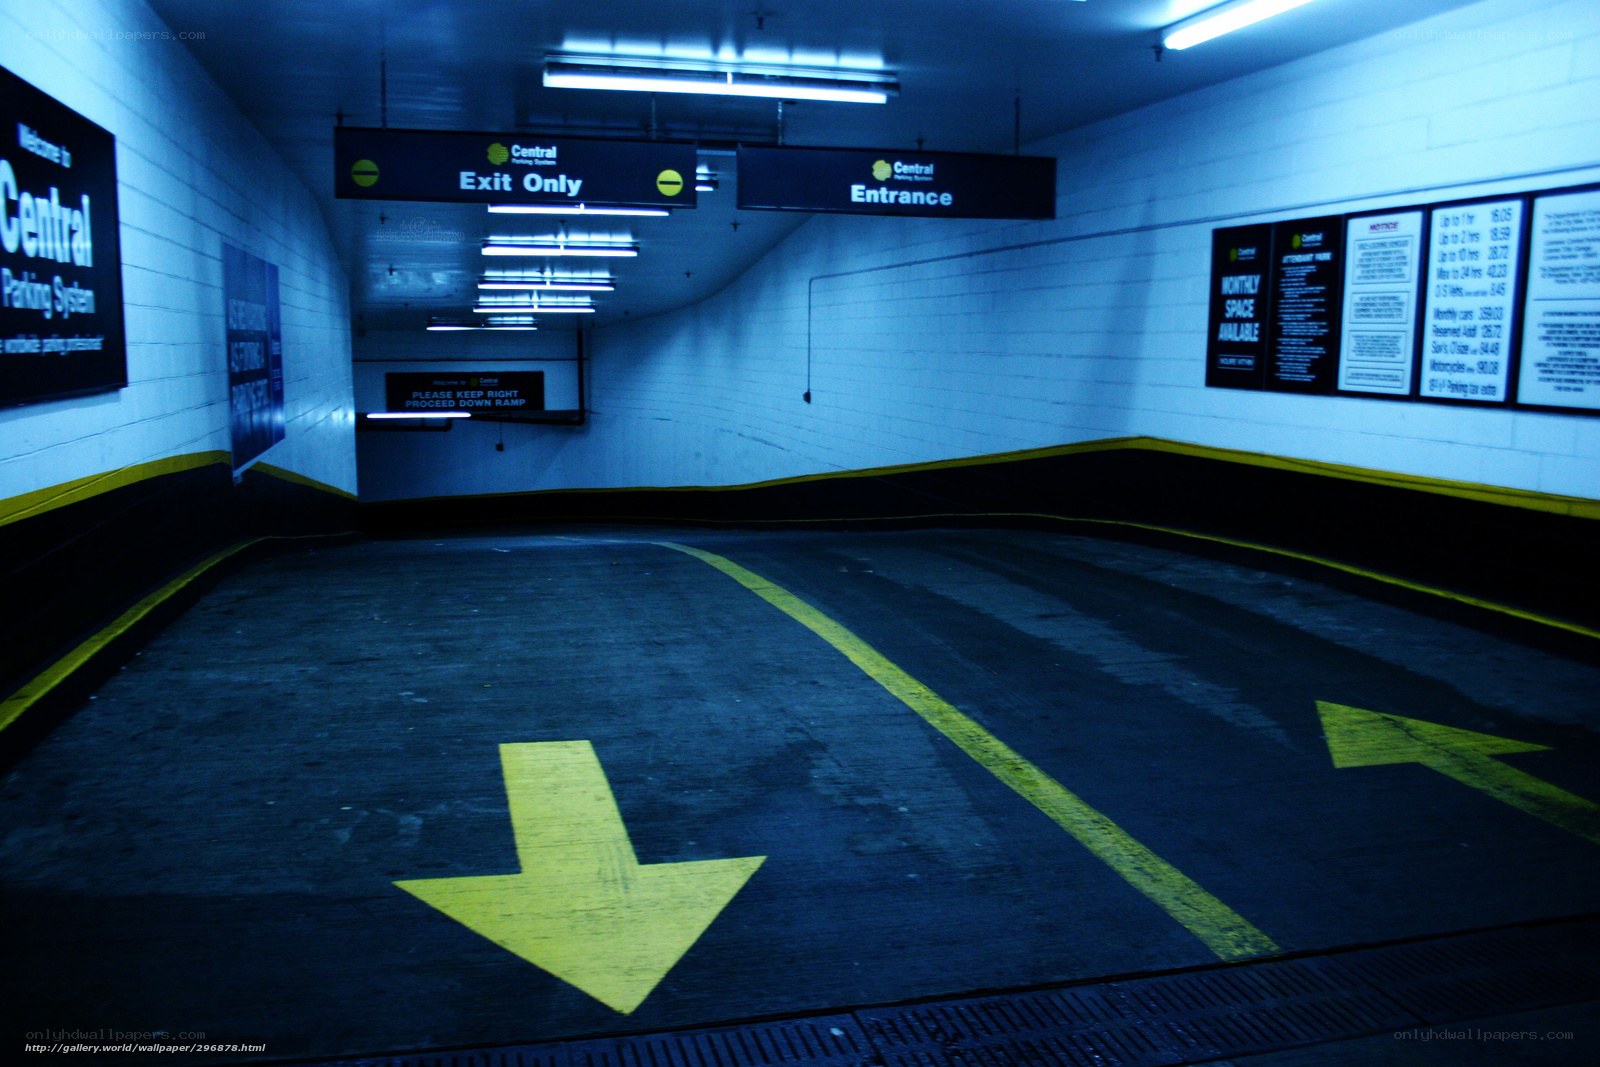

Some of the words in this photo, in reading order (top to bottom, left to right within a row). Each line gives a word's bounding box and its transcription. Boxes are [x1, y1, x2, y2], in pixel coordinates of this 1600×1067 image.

[18, 122, 60, 164] Welcome
[61, 146, 71, 169] to
[511, 144, 557, 159] Central
[893, 161, 934, 175] Central
[459, 171, 513, 192] Exit
[522, 173, 583, 197] Only
[850, 184, 953, 206] Entrance
[0, 159, 92, 267] Central
[1440, 214, 1450, 228] Up
[1451, 214, 1460, 227] to
[1490, 207, 1513, 223] 16.05
[1369, 221, 1399, 232] NOTICE
[1439, 231, 1449, 246] Up
[1450, 231, 1459, 244] to
[1467, 229, 1480, 243] hrs
[1489, 226, 1511, 242] 18.59
[1437, 249, 1448, 264] Up
[1448, 250, 1457, 262] to
[1467, 247, 1480, 261] hrs
[1487, 244, 1510, 260] 28.72
[1450, 267, 1460, 280] to
[1460, 265, 1470, 280] 24
[1471, 265, 1483, 279] hrs
[1, 267, 52, 320] Parking
[53, 274, 96, 320] System
[1221, 275, 1260, 295] MONTHLY
[1225, 299, 1254, 318] SPACE
[1433, 307, 1456, 323] Monthly
[1458, 309, 1474, 321] cars
[1218, 322, 1259, 341] AVAILABLE
[1431, 323, 1461, 338] Reserved
[1429, 358, 1466, 375] Motorcycles
[412, 391, 453, 399] PLEASE
[456, 390, 484, 399] KEEP
[487, 389, 520, 398] RIGHT
[1446, 379, 1469, 398] Parking
[405, 399, 456, 408] PROCEED
[459, 398, 492, 407] DOWN
[495, 398, 527, 407] RAMP
